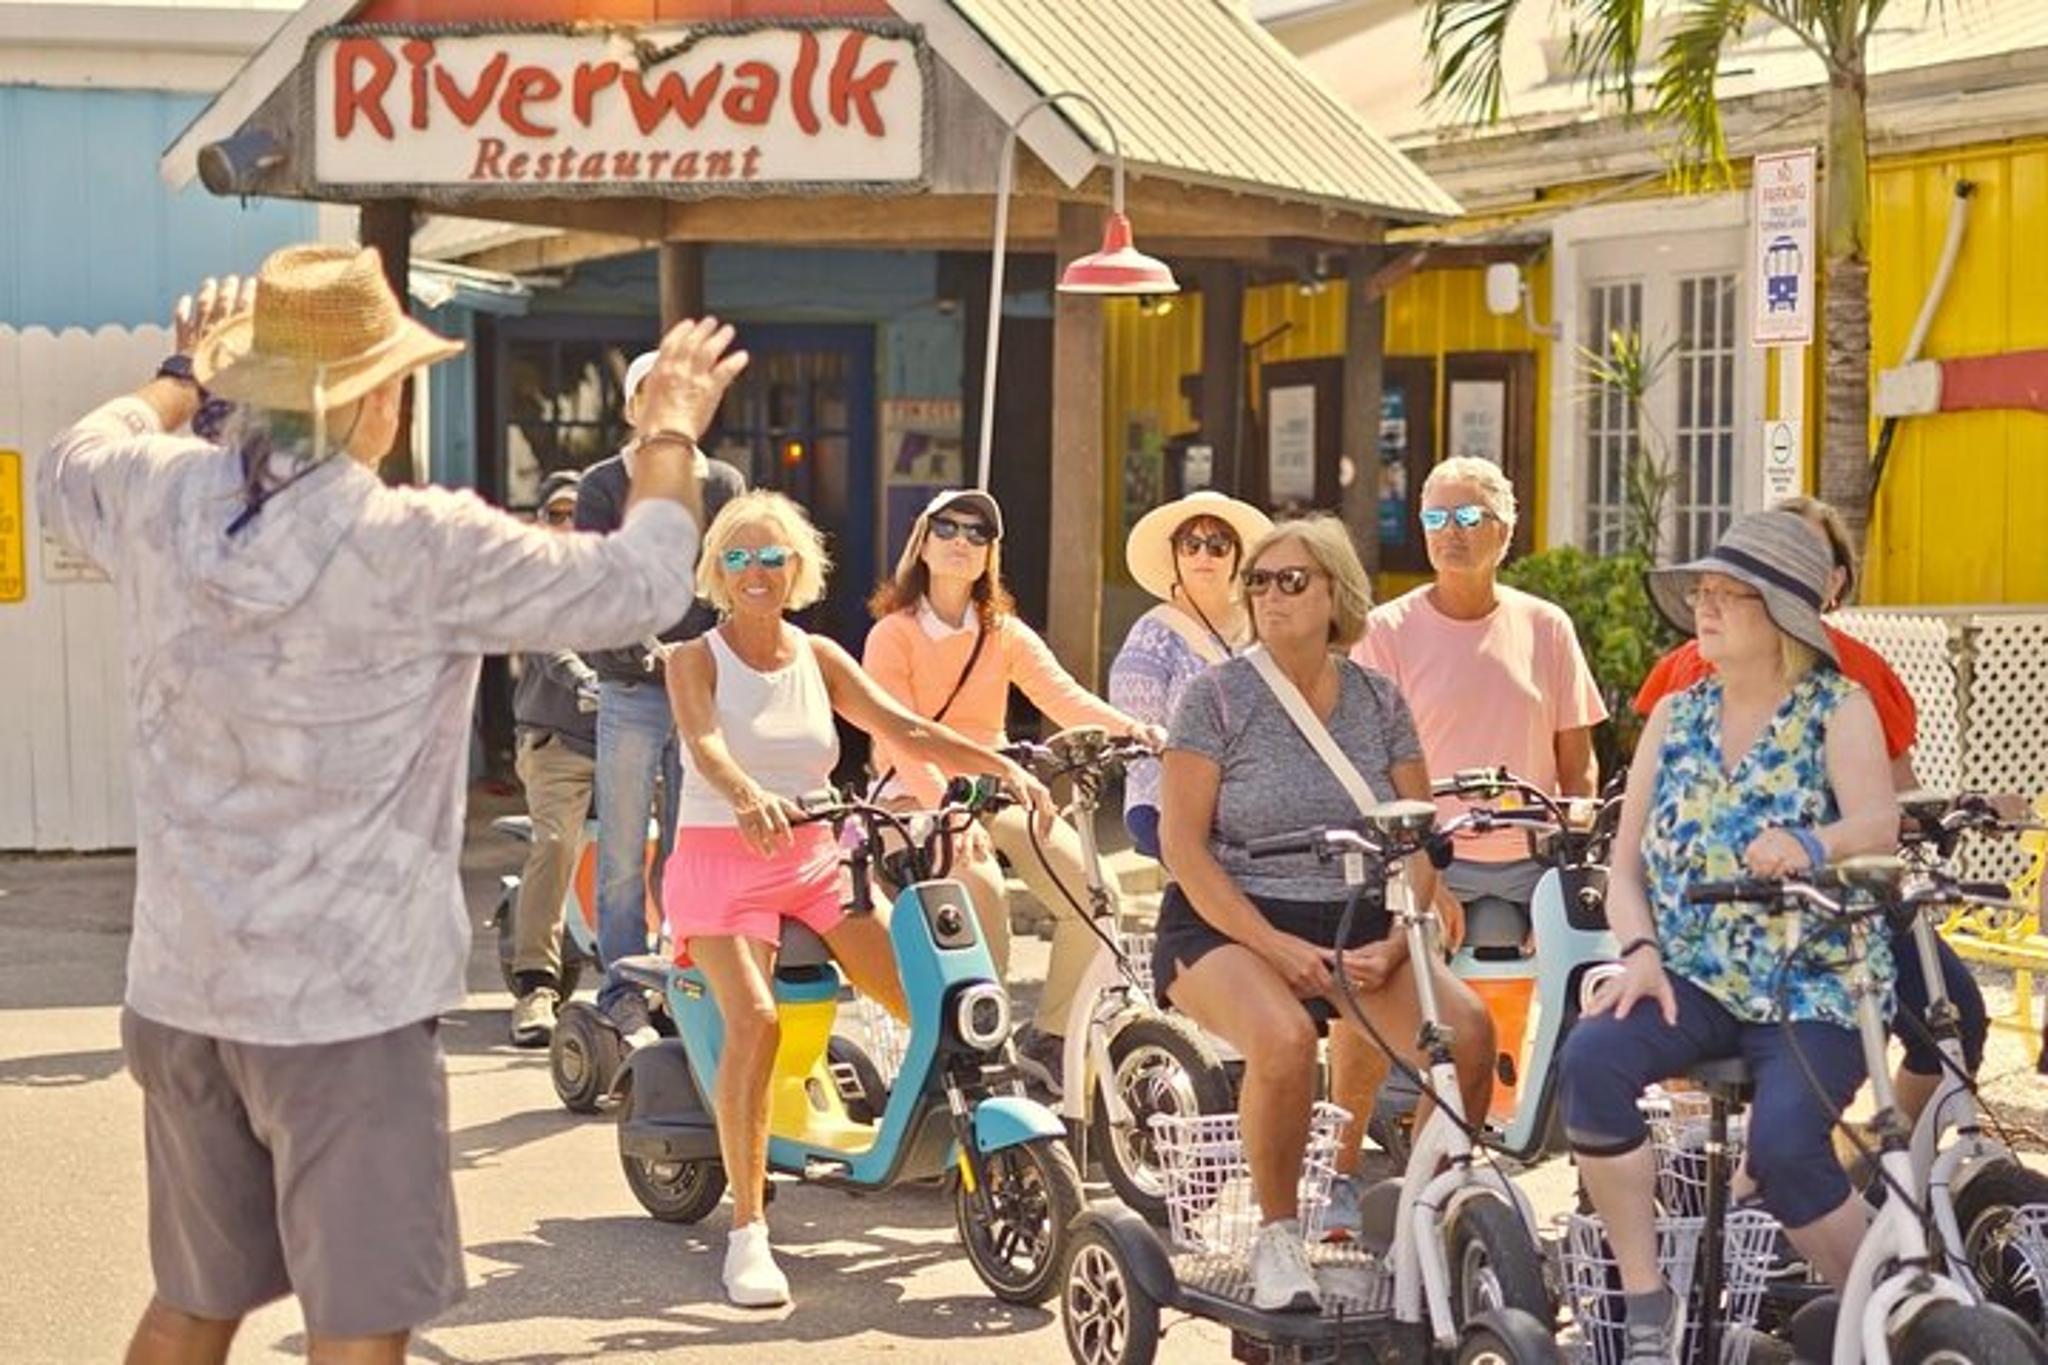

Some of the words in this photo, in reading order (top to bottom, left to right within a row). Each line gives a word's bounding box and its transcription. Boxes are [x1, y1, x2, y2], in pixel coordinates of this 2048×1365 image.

[334, 29, 898, 140] Riverwalk
[469, 138, 761, 180] Restaurant
[1763, 182, 1806, 203] PARKING
